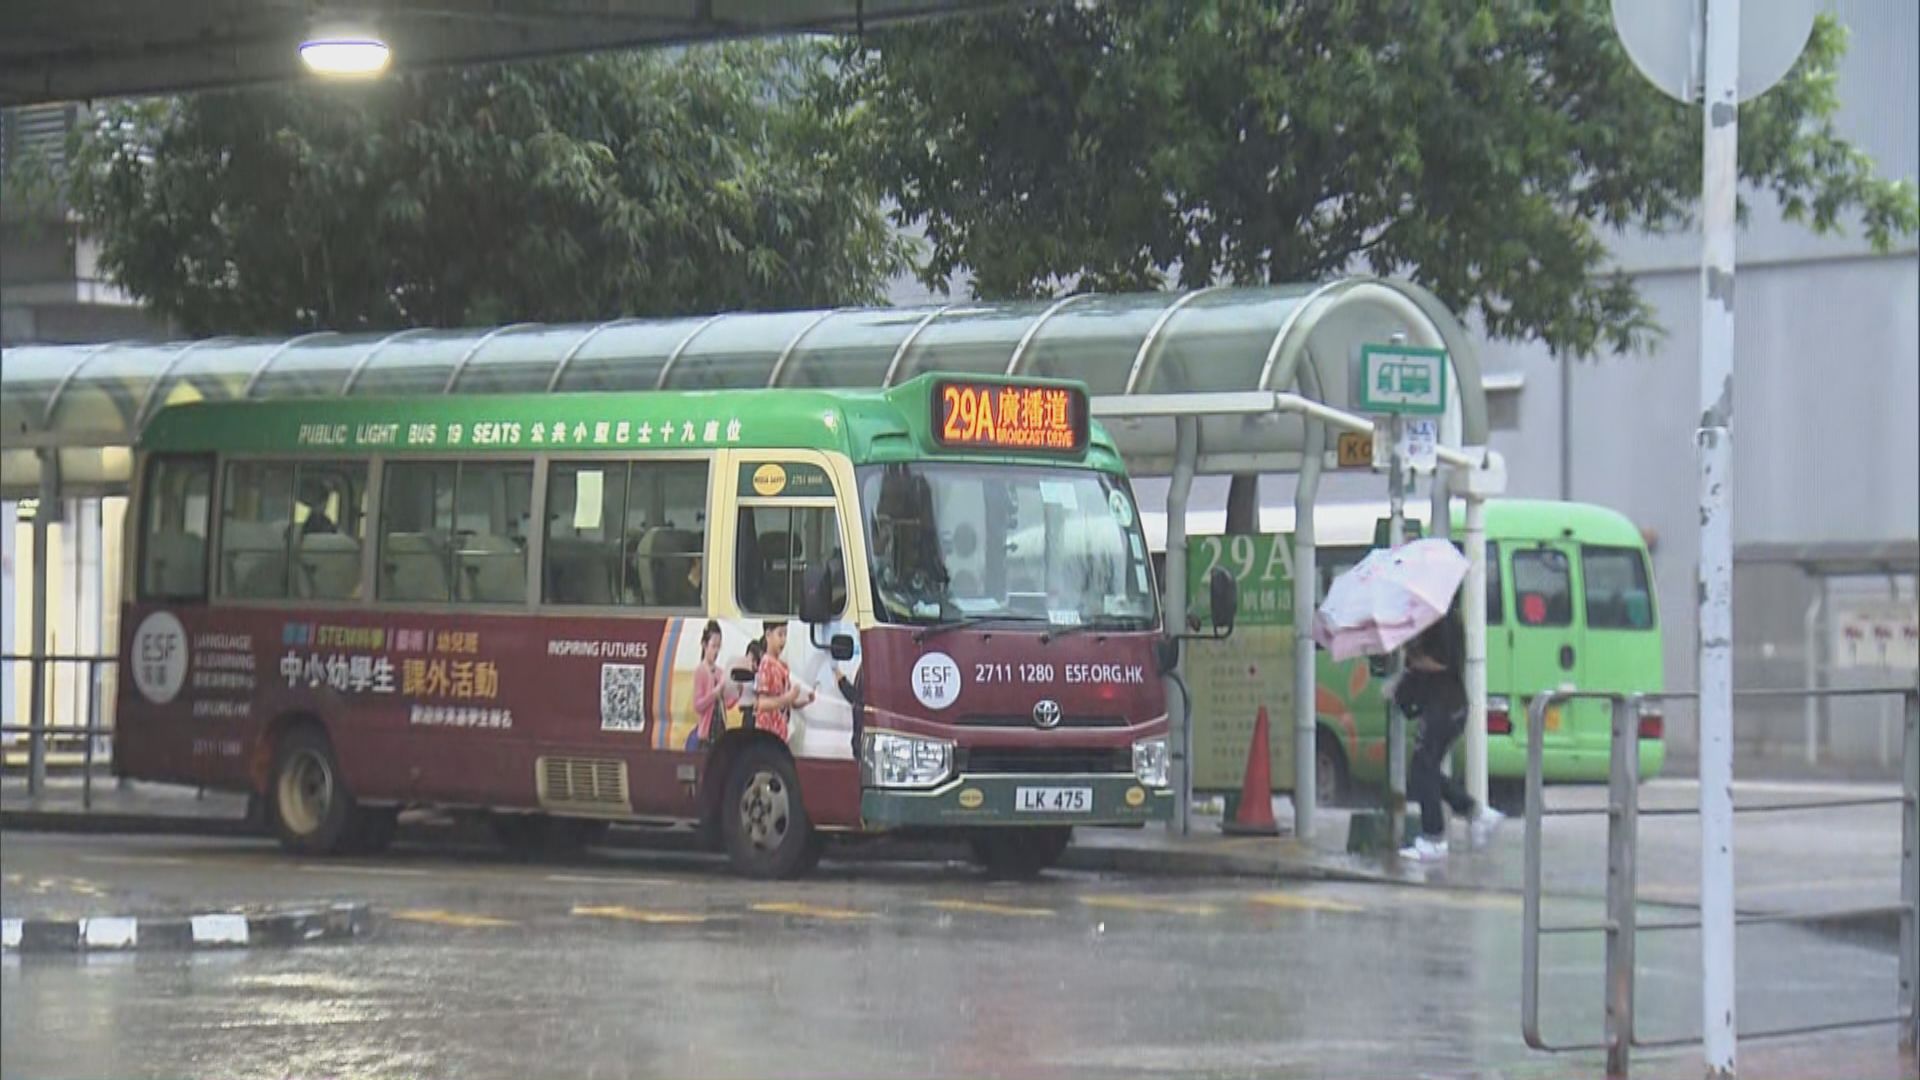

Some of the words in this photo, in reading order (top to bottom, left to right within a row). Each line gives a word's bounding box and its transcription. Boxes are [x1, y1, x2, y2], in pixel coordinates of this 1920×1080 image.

[944, 386, 995, 441] 29A
[997, 387, 1069, 430] 廣播道
[298, 424, 347, 444] PUBLIC
[356, 424, 399, 444] LIGHT
[408, 424, 436, 444] BUS
[447, 424, 462, 443] 19
[472, 422, 521, 444] SEATS
[996, 428, 1045, 445] BROADCAST
[1047, 430, 1072, 448] DRIVE
[1200, 534, 1294, 583] 29A
[142, 633, 177, 661] ESF
[547, 640, 599, 656] INSPIRING
[600, 641, 648, 657] FUTURES
[280, 649, 396, 694] 中小幼學生
[402, 658, 499, 699] 課外活動
[920, 666, 951, 683] ESF
[975, 663, 1012, 683] 2711
[1018, 664, 1054, 683] 1280
[1065, 664, 1144, 684] ESF.ORG.HK
[1024, 791, 1045, 809] LK
[1053, 791, 1084, 808] 475
